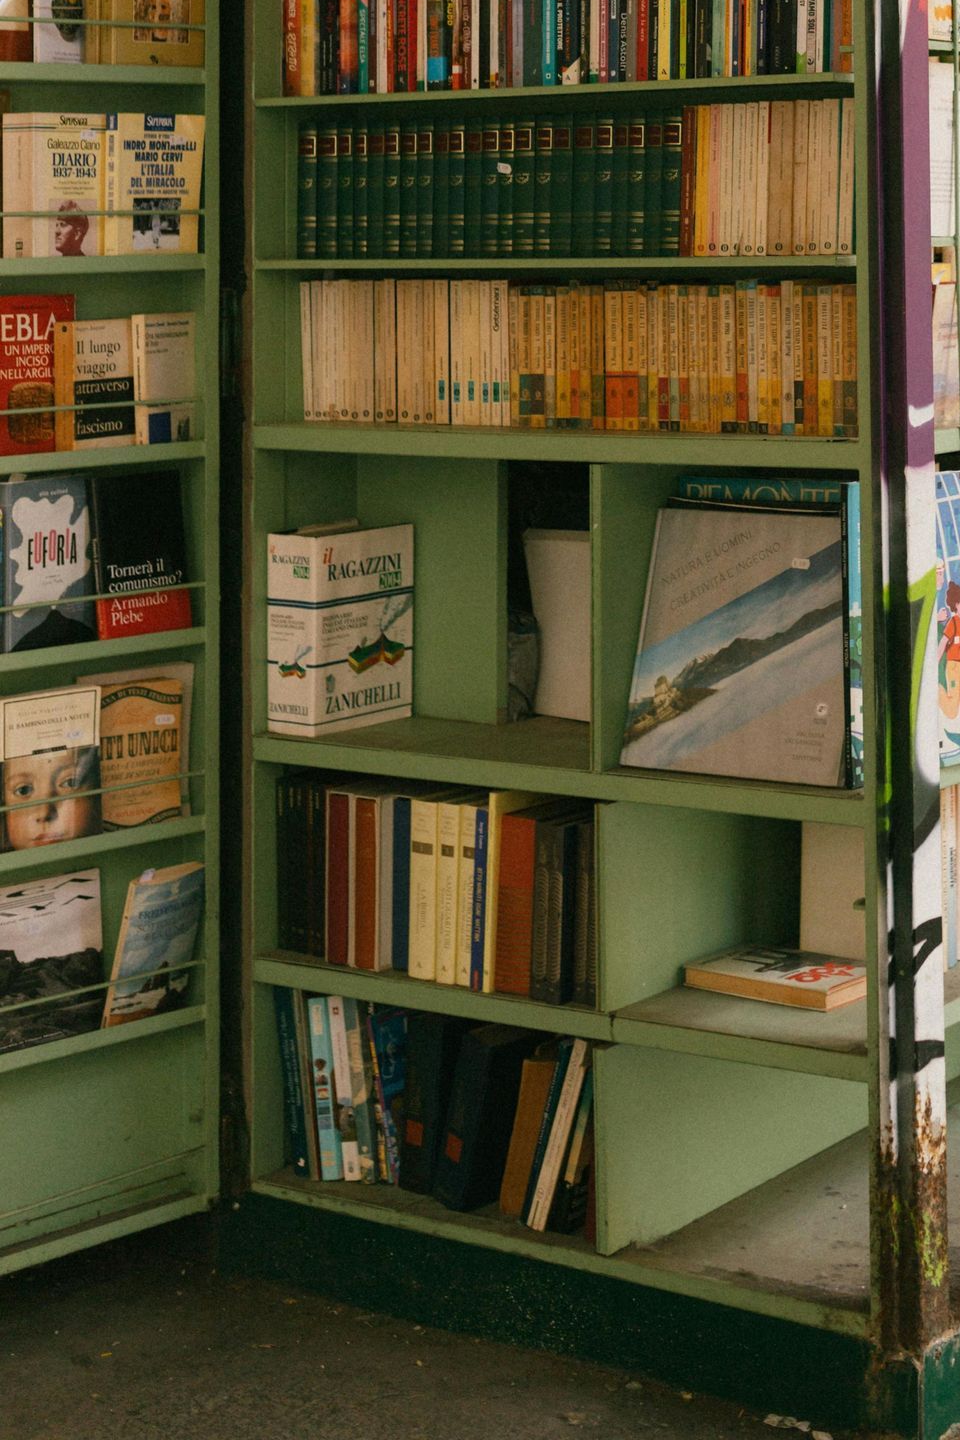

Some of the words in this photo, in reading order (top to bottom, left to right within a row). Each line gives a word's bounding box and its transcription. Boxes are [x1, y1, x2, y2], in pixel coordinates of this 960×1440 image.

[620, 12, 628, 39] Denis
[397, 36, 407, 72] ROSE
[47, 138, 79, 151] Galeazzo
[80, 139, 100, 151] Ciano
[123, 141, 146, 151] INDRO
[52, 153, 97, 167] DIARIO
[135, 152, 158, 162] MARIO
[161, 152, 183, 162] CERVI
[52, 167, 97, 179] 1937-1943
[141, 164, 175, 176] L'ITALIA
[130, 177, 144, 188] DEL
[145, 177, 186, 188] MIRACOLO
[1, 312, 57, 342] EBLA
[4, 345, 21, 356] UN
[76, 341, 85, 355] Il
[89, 339, 121, 357] lungo
[16, 356, 49, 368] INCISO
[76, 362, 117, 378] viaggio
[76, 379, 130, 395] attraverso
[76, 418, 123, 435] fascismo
[27, 528, 78, 571] EUFORIA
[714, 529, 754, 558] UOMINI
[272, 554, 310, 566] RAGAZZINI
[323, 547, 333, 565] il
[107, 560, 154, 579] Tornerà
[156, 558, 165, 572] il
[328, 553, 402, 582] RAGAZZINI
[108, 570, 183, 593] comunismo?
[110, 592, 168, 612] Armando
[111, 610, 144, 626] Plebe
[326, 682, 401, 715] ZANICHELLI
[270, 703, 309, 716] ZANICHELLI
[16, 719, 48, 730] BAMBINO
[69, 712, 90, 722] NOTTE
[128, 728, 178, 758] UNICI
